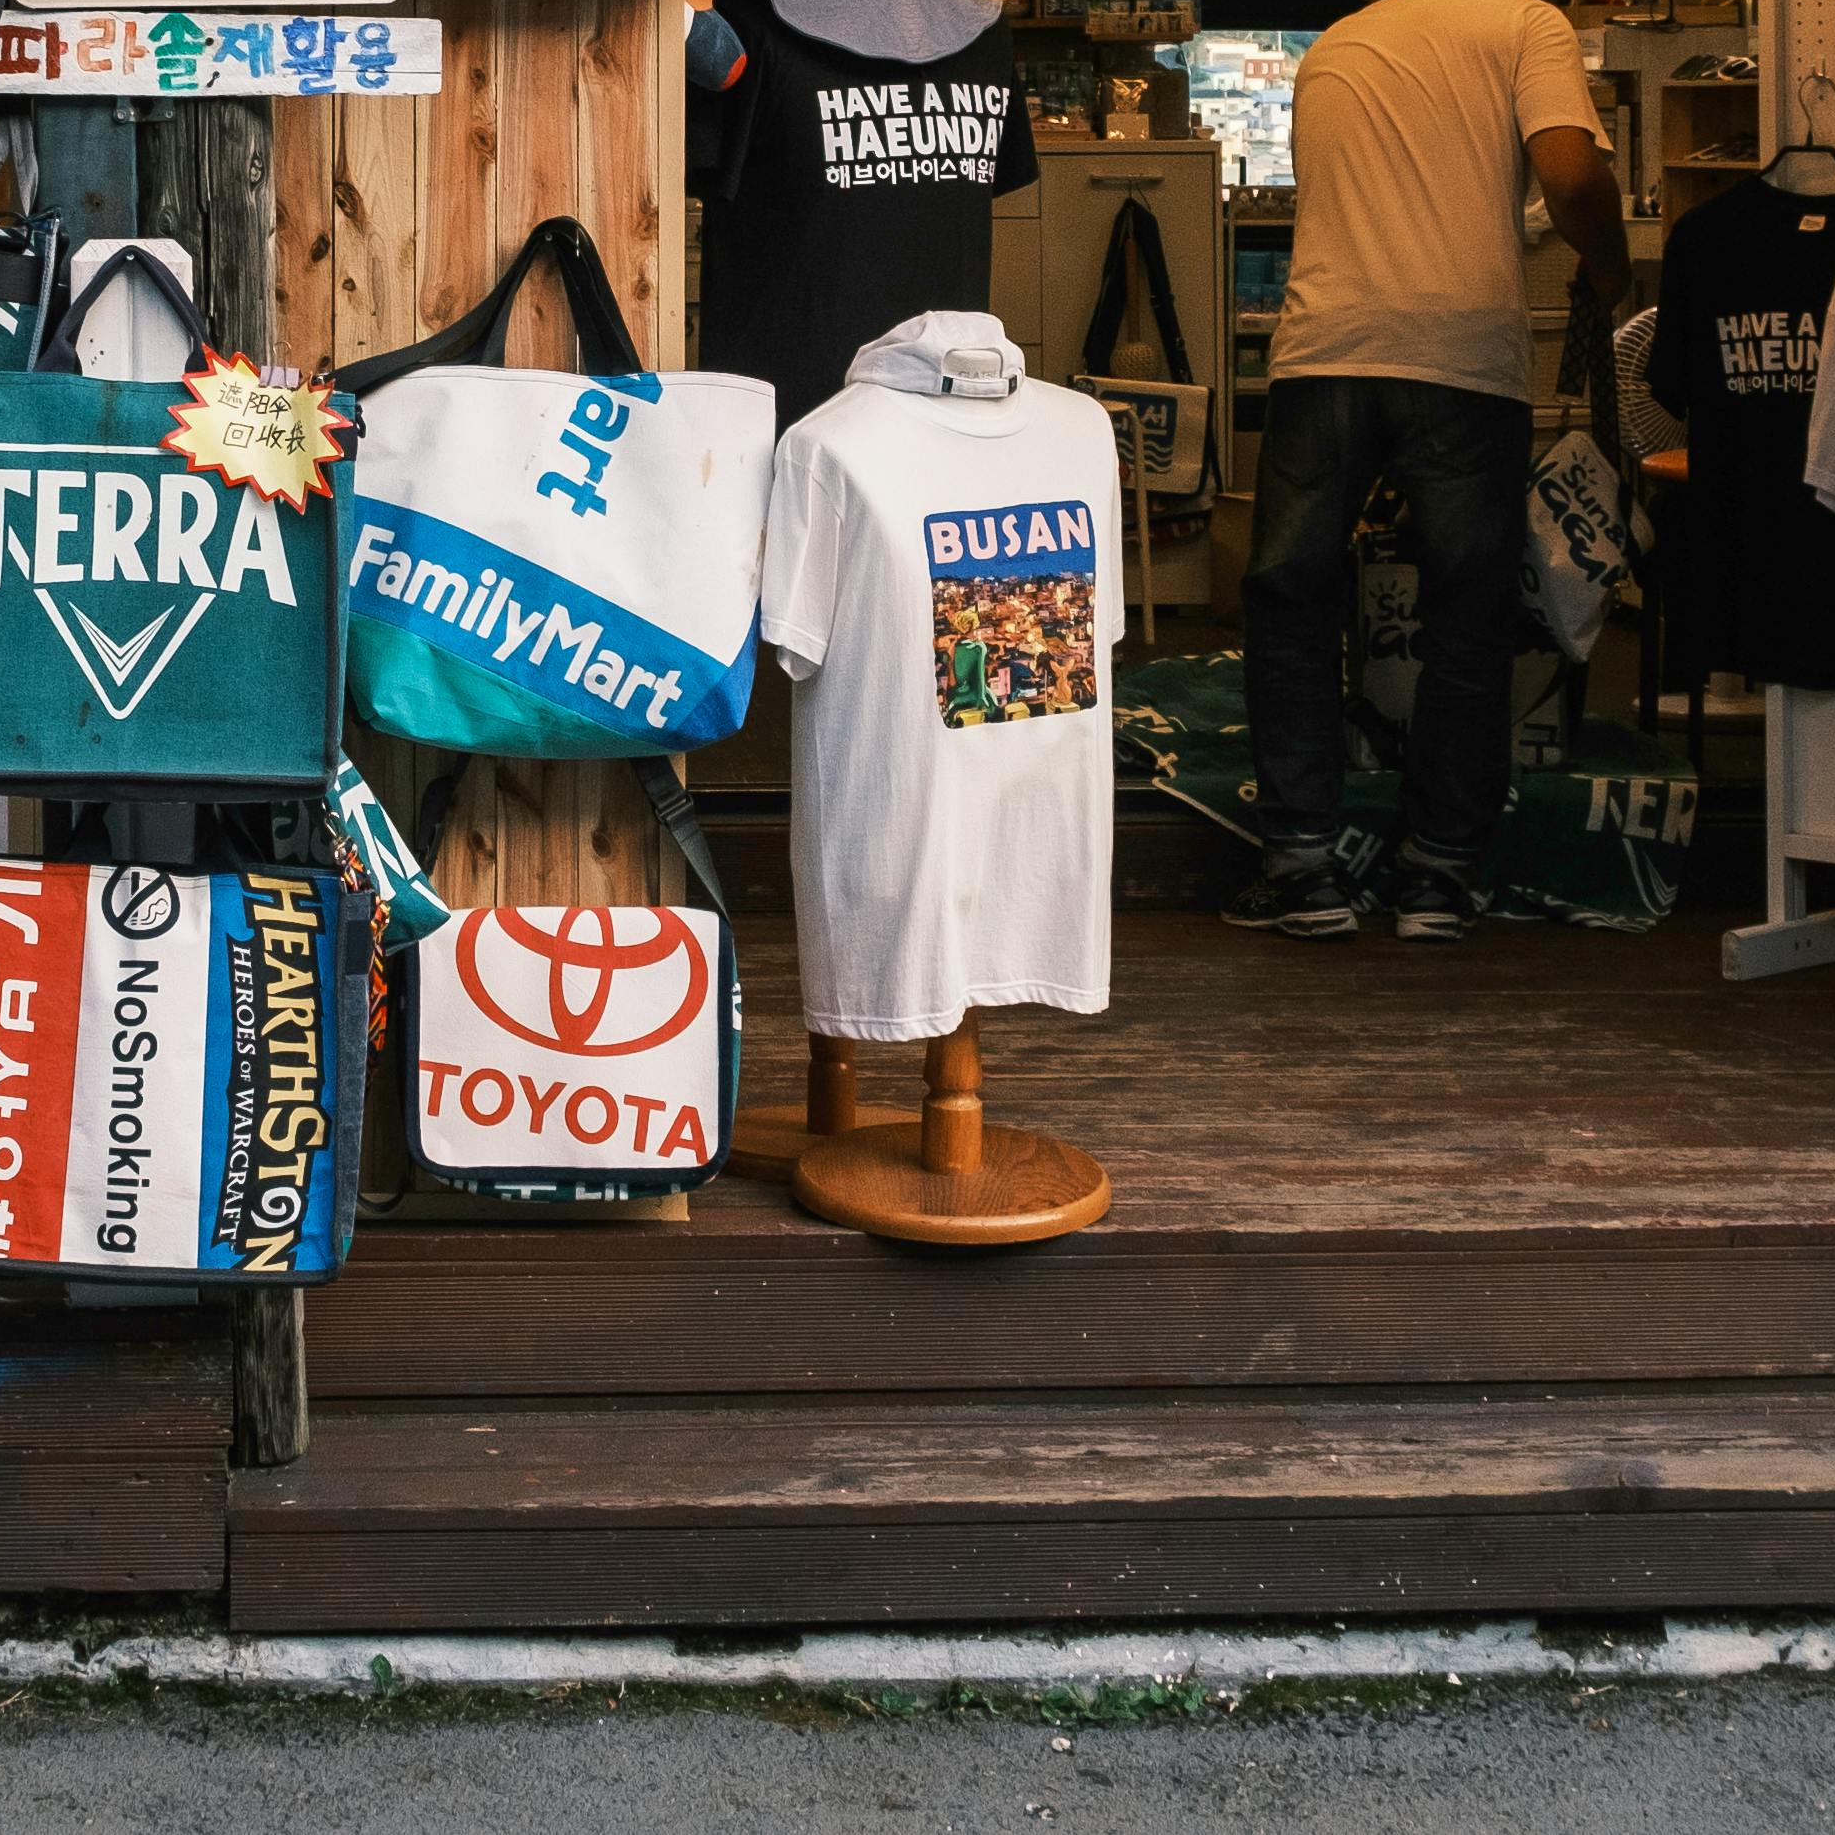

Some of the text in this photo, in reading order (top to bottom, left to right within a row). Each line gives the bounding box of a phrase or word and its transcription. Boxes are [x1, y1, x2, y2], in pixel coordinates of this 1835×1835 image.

[816, 84, 913, 120] HAVE
[923, 82, 945, 113] A
[821, 115, 1005, 162] HAEUNDA
[825, 159, 958, 189] 해브어나이스
[1716, 312, 1817, 341] HAVE A
[929, 502, 1091, 566] BUSAN
[349, 523, 683, 729] FamilyMart
[231, 943, 257, 1057] HEROES
[418, 1058, 710, 1168] TOYOTA
[215, 1085, 256, 1240] WARCRAFT
